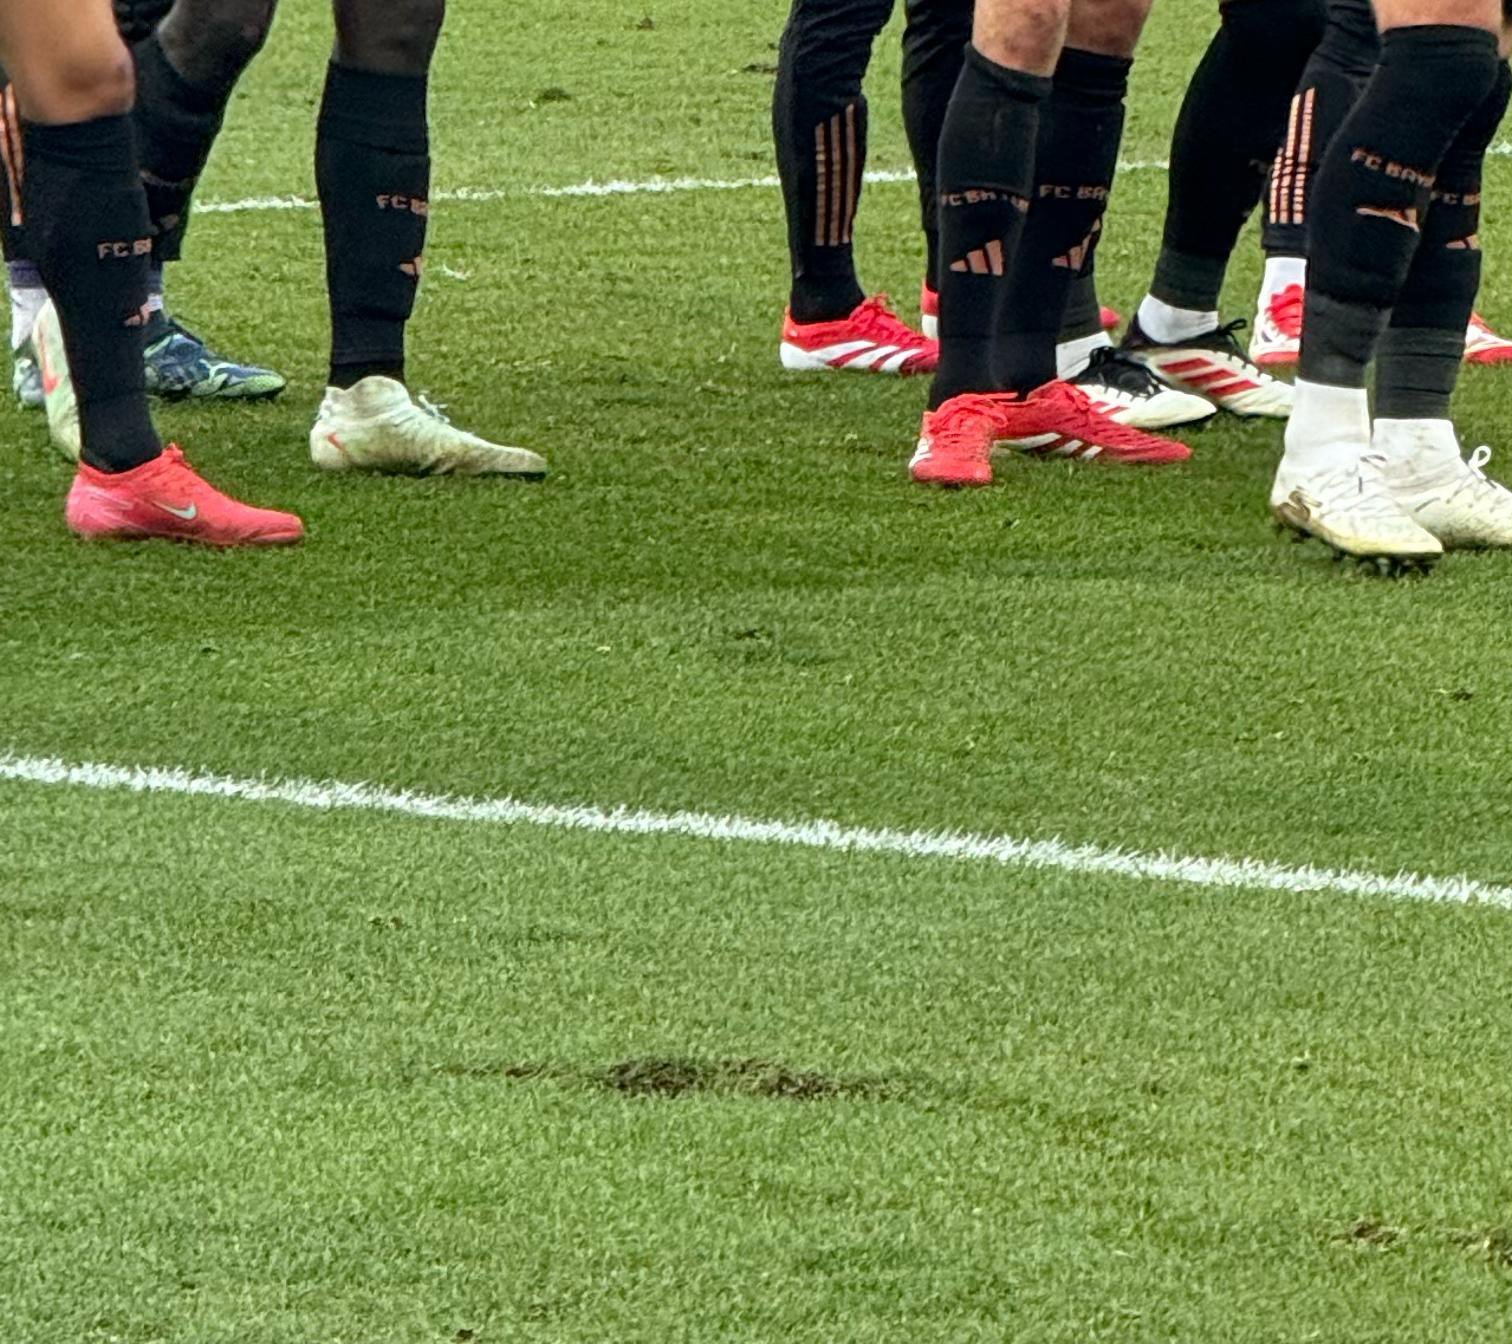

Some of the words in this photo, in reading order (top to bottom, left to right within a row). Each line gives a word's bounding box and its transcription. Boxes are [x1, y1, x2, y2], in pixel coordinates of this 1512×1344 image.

[1038, 184, 1072, 199] FC
[376, 194, 408, 210] FC
[97, 242, 129, 260] FC
